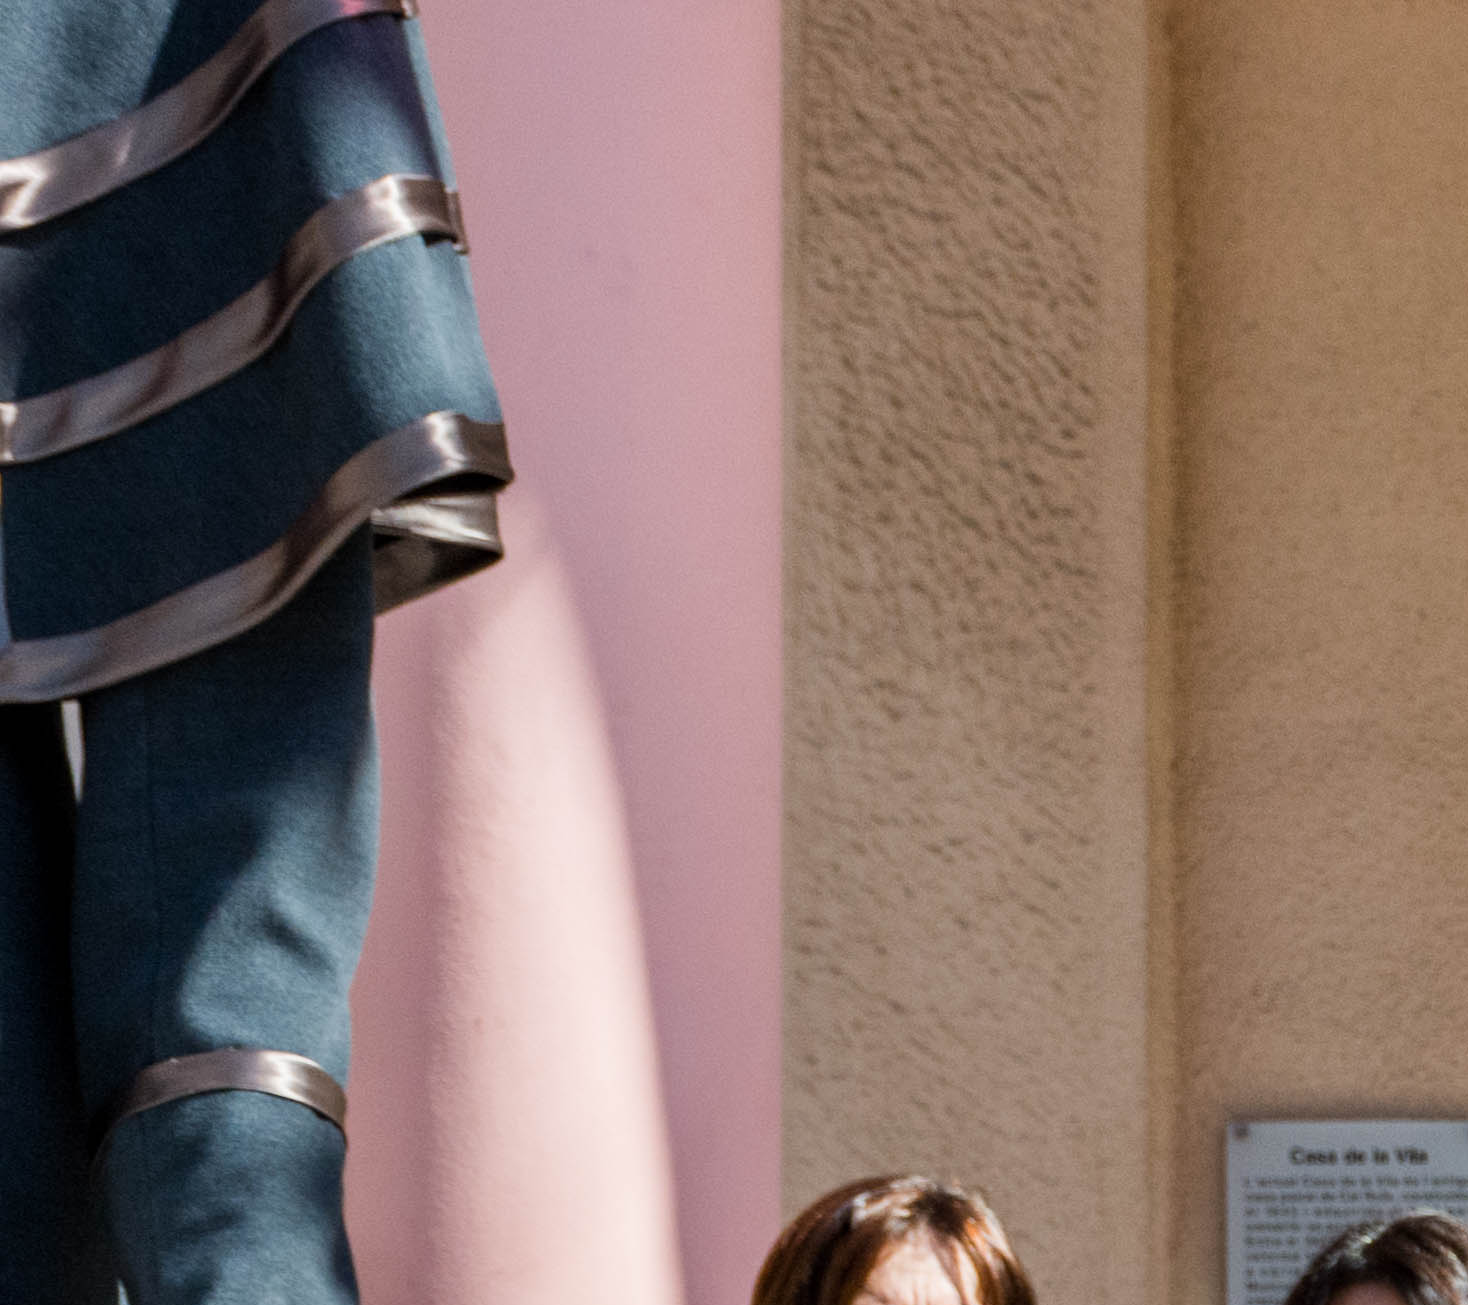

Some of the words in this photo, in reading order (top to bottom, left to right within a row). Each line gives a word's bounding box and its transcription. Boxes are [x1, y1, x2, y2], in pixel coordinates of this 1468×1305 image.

[1289, 1146, 1337, 1166] Casa
[1343, 1145, 1366, 1166] de
[1371, 1145, 1388, 1166] la
[1395, 1145, 1428, 1166] Vila
